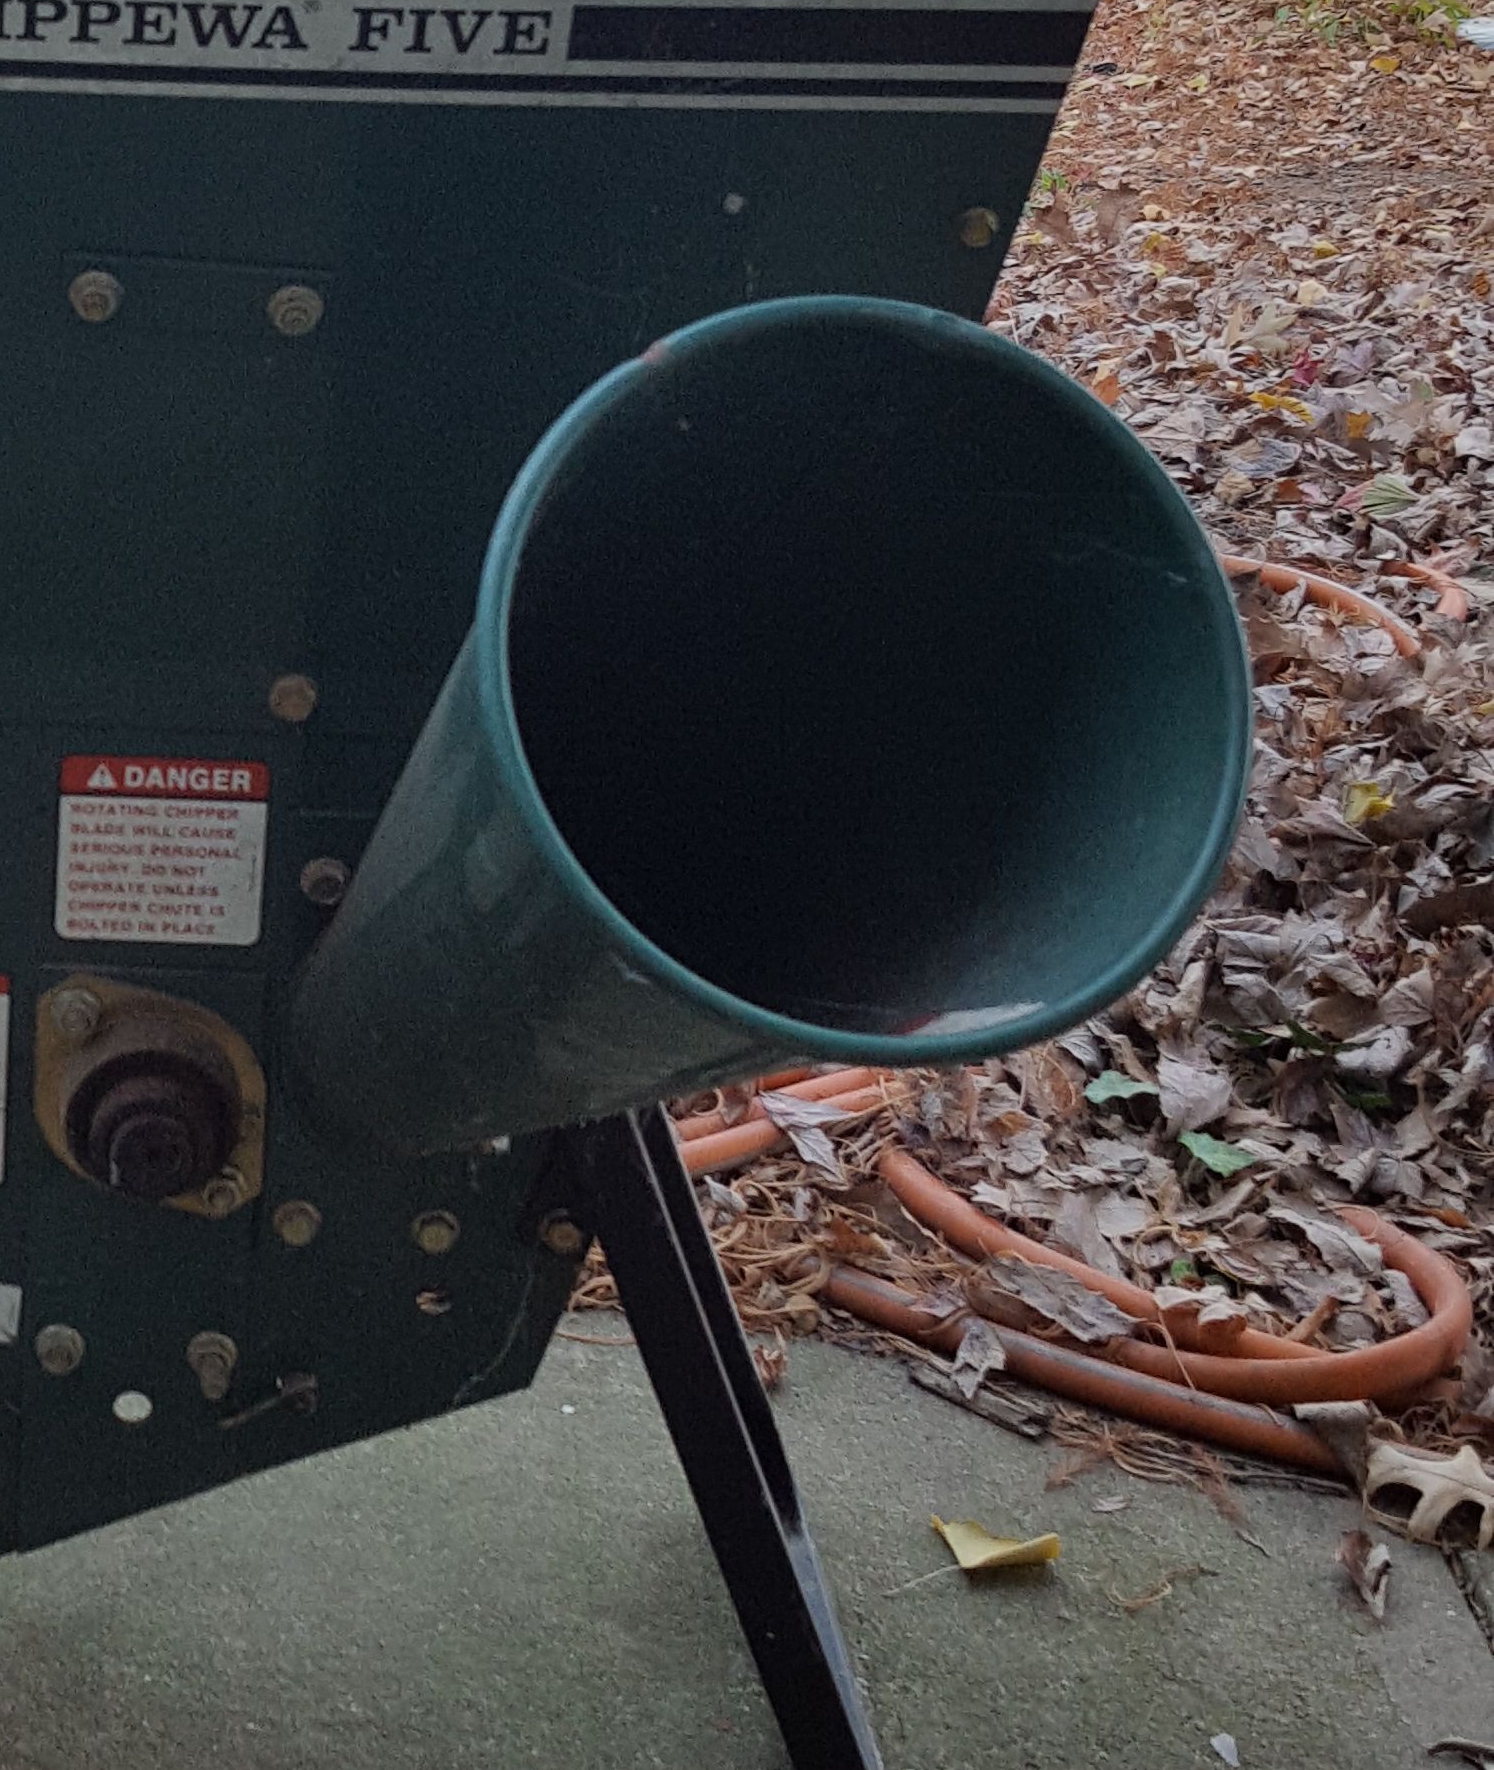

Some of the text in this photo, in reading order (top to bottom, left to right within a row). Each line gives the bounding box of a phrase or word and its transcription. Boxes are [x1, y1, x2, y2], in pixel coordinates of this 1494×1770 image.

[348, 6, 554, 57] FIVE
[124, 765, 251, 792] DANGER
[70, 804, 239, 820] ROTATING CHIPPER
[70, 823, 236, 839] BLADE WILL CAUSE
[70, 843, 241, 859] SERIOUS PERSONAL
[142, 864, 166, 876] DO
[171, 865, 204, 876] NOT
[69, 881, 219, 897] OPERATE UNLESS
[147, 903, 202, 916] CHUTE
